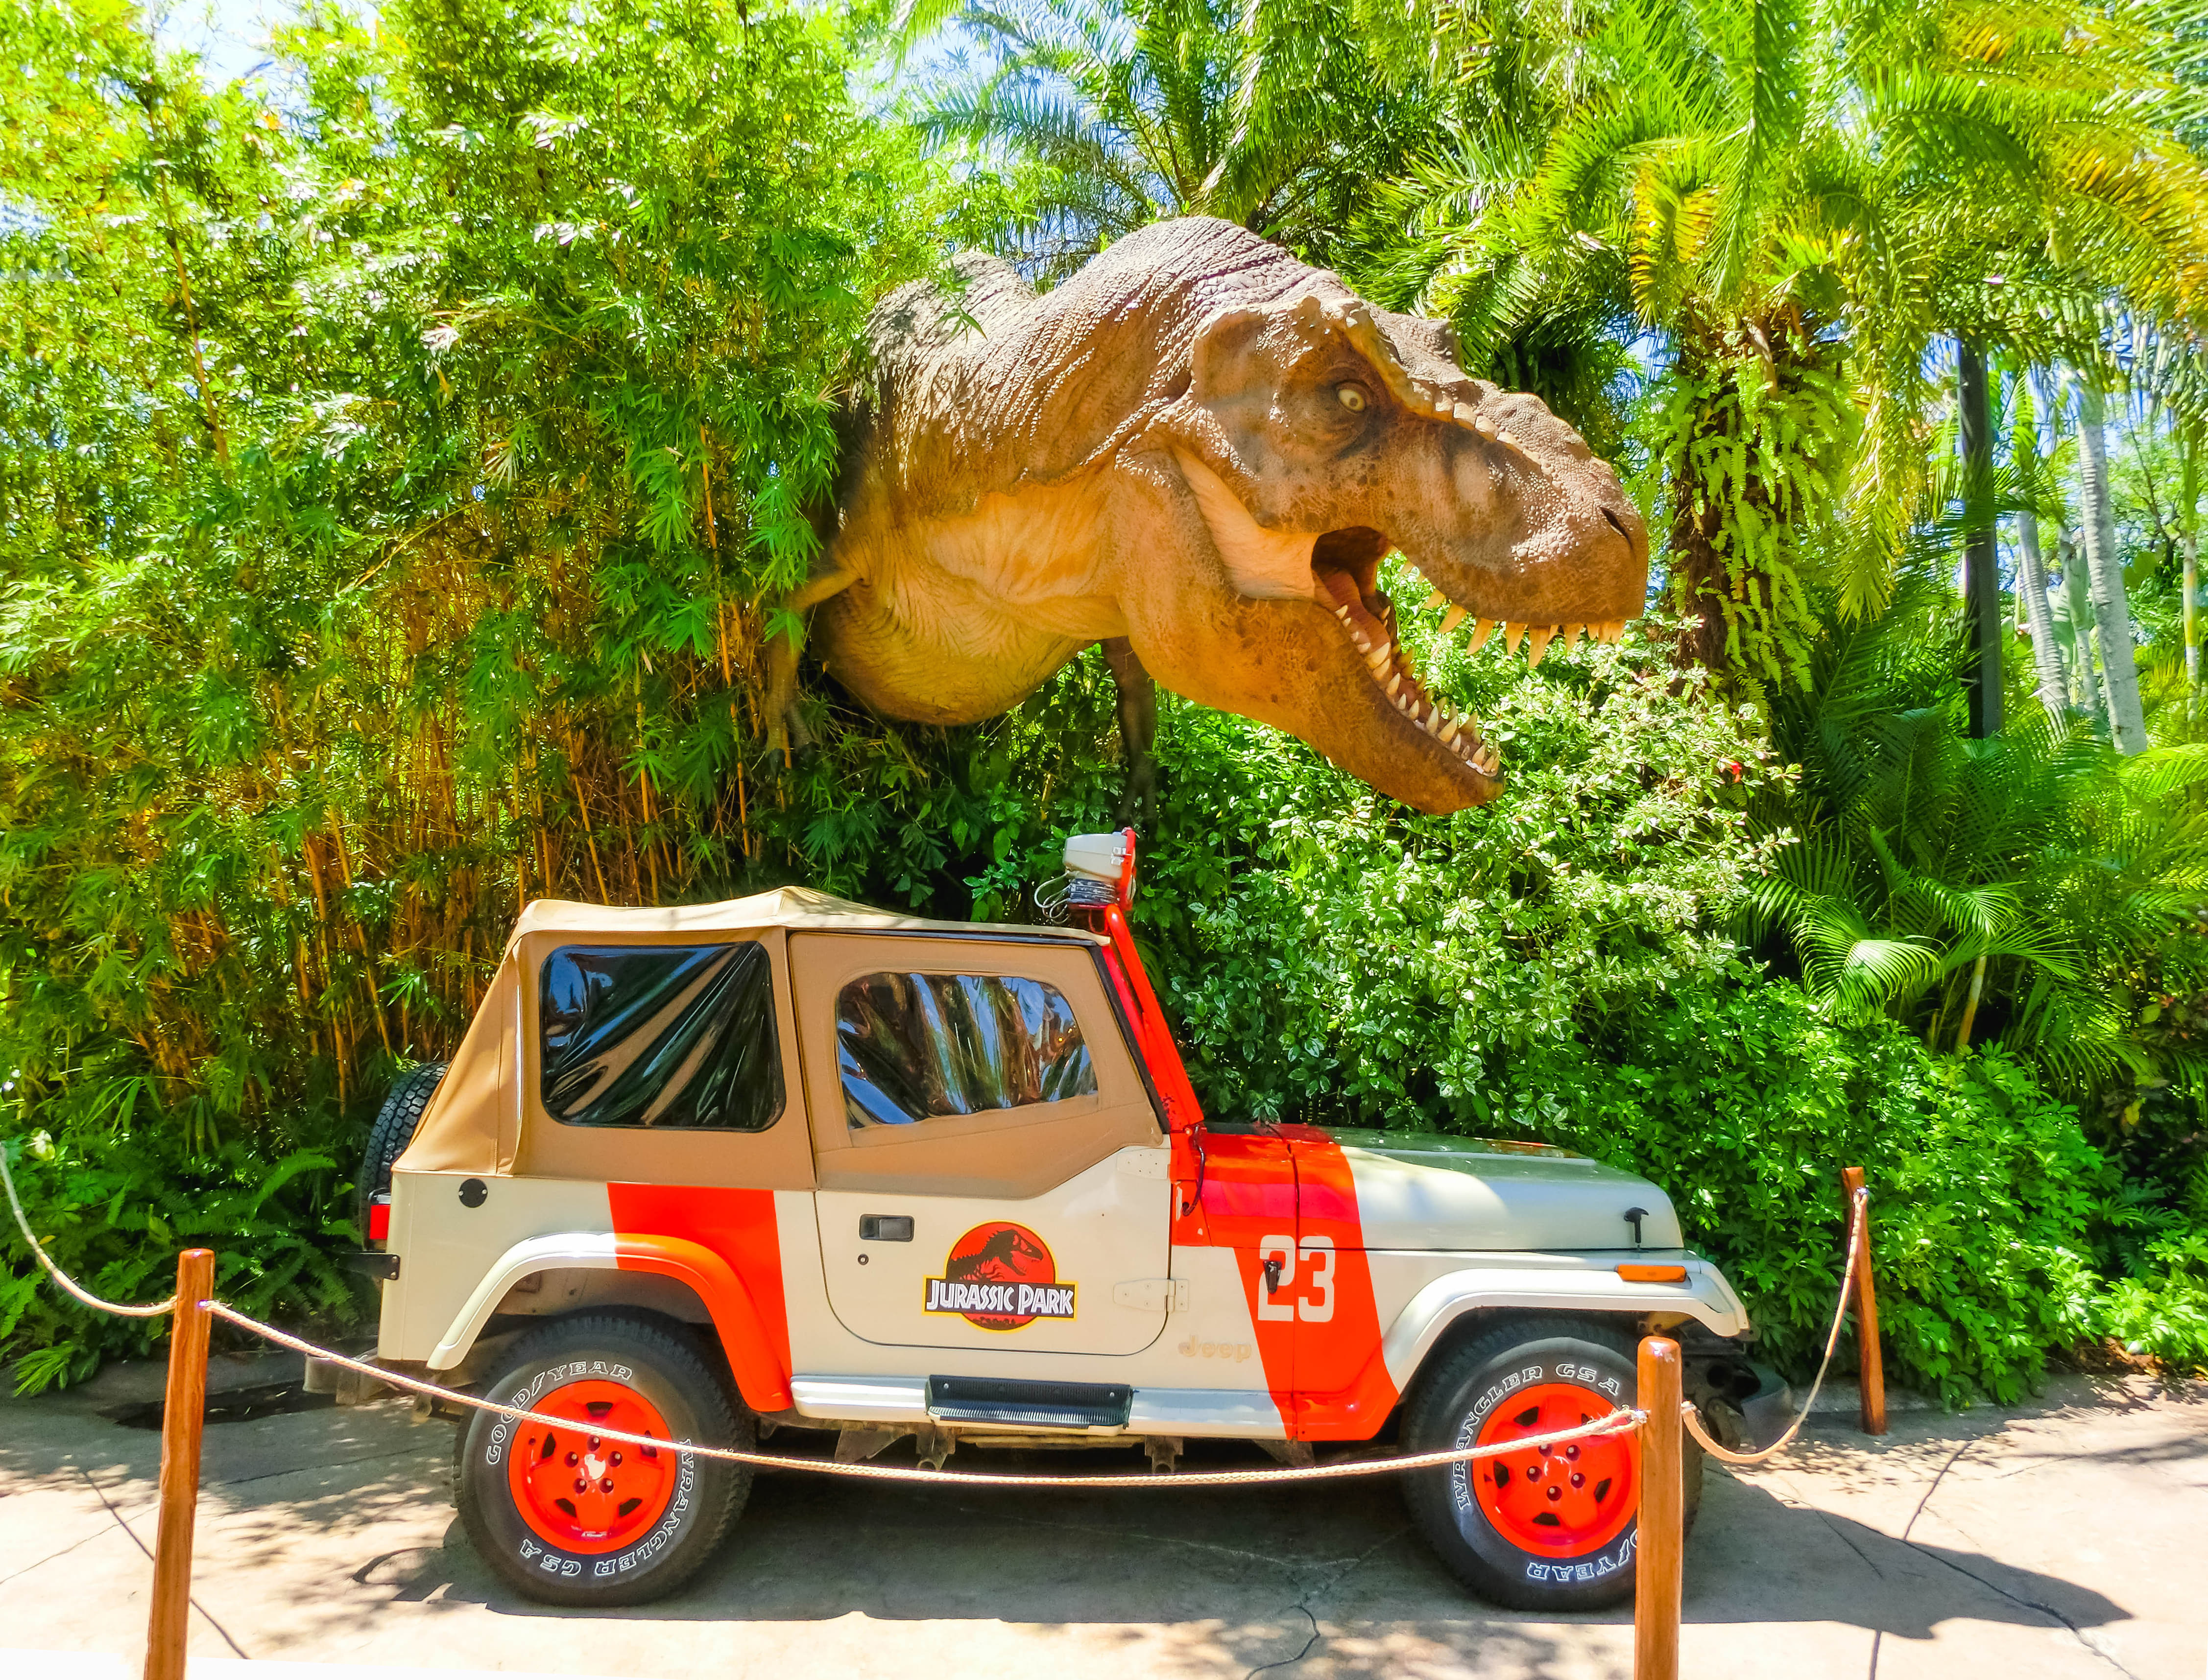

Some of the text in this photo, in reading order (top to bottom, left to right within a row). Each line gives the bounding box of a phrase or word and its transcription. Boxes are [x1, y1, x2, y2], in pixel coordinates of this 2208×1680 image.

[926, 1279, 1074, 1315] JURASSIC PARK
[1257, 1234, 1336, 1323] 23
[1452, 1363, 1621, 1511] WRANGLER GSA
[519, 1438, 694, 1577] WRANGLER GSA
